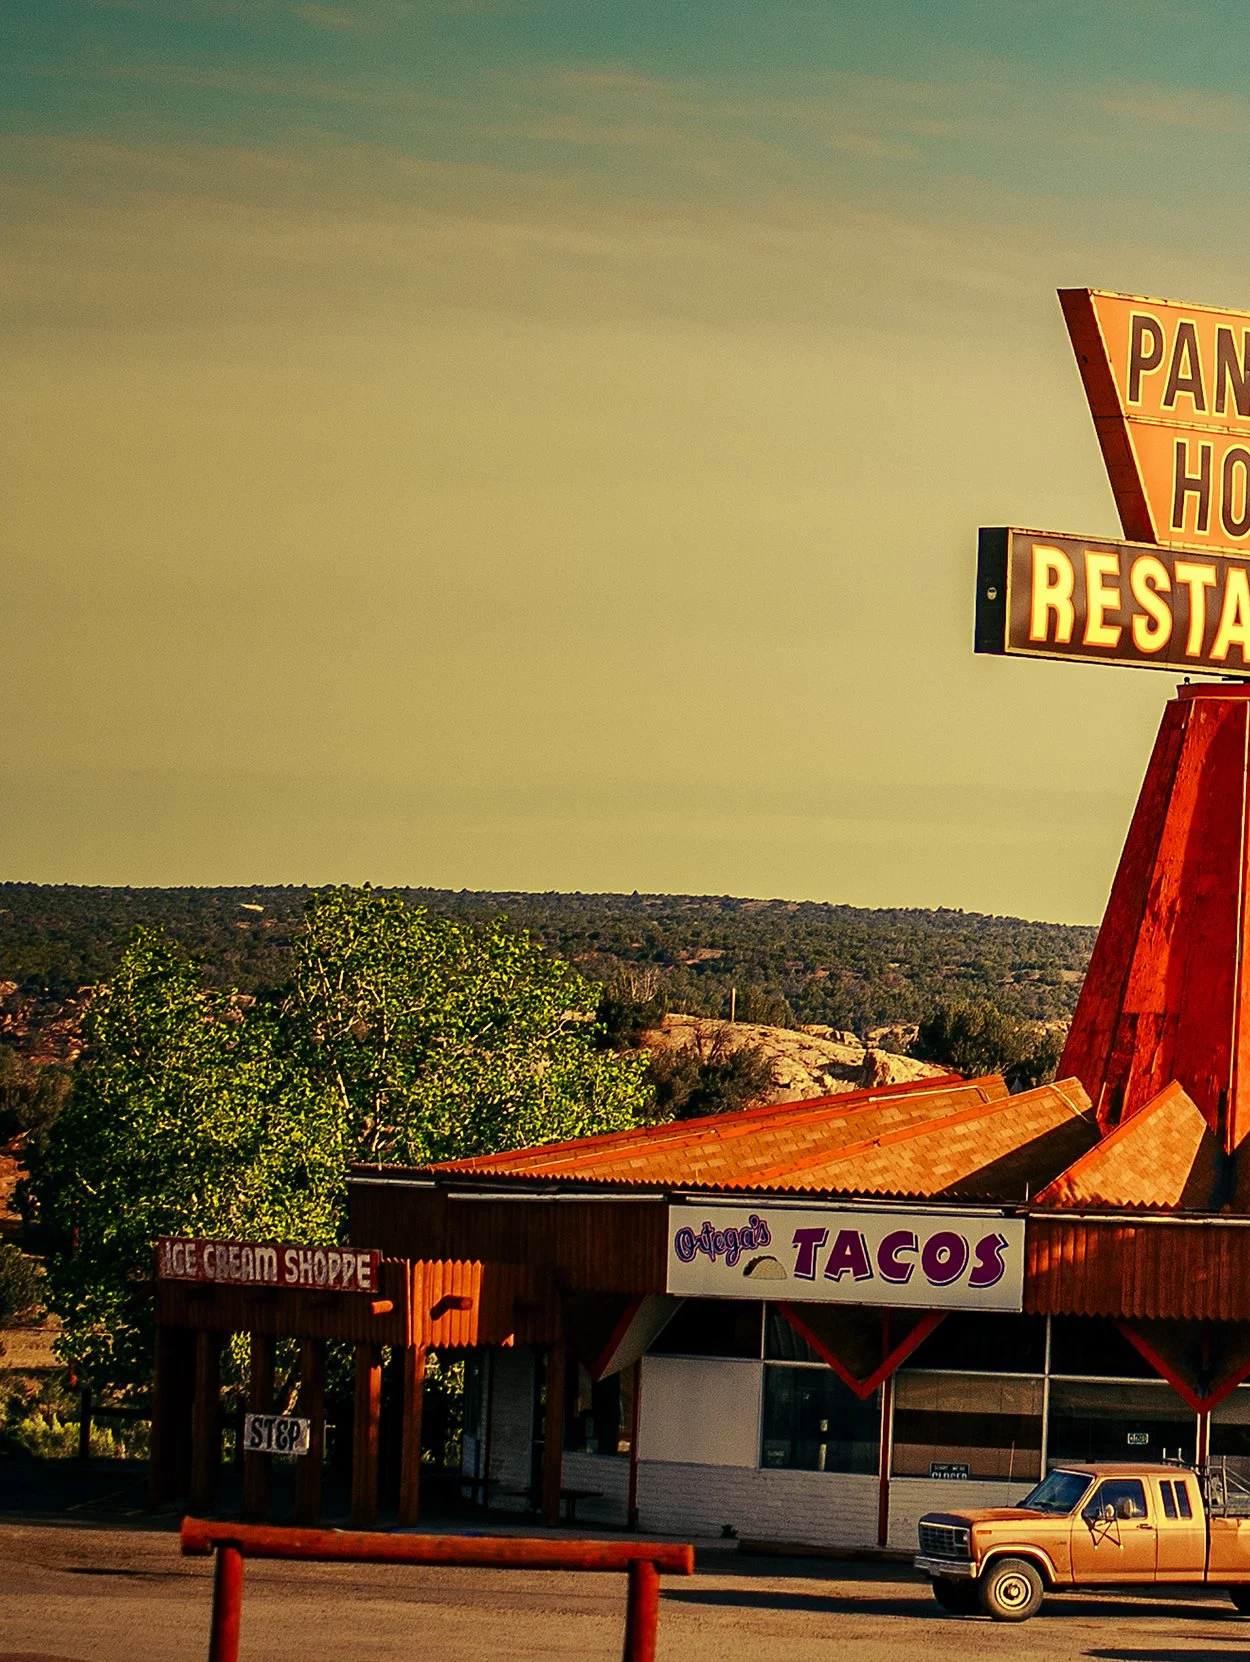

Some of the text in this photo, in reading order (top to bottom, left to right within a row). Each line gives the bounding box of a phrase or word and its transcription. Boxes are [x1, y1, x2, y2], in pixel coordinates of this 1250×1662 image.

[163, 1241, 371, 1288] ICE CREAM SHOPPE
[674, 1215, 1008, 1289] Ortega's TACOS
